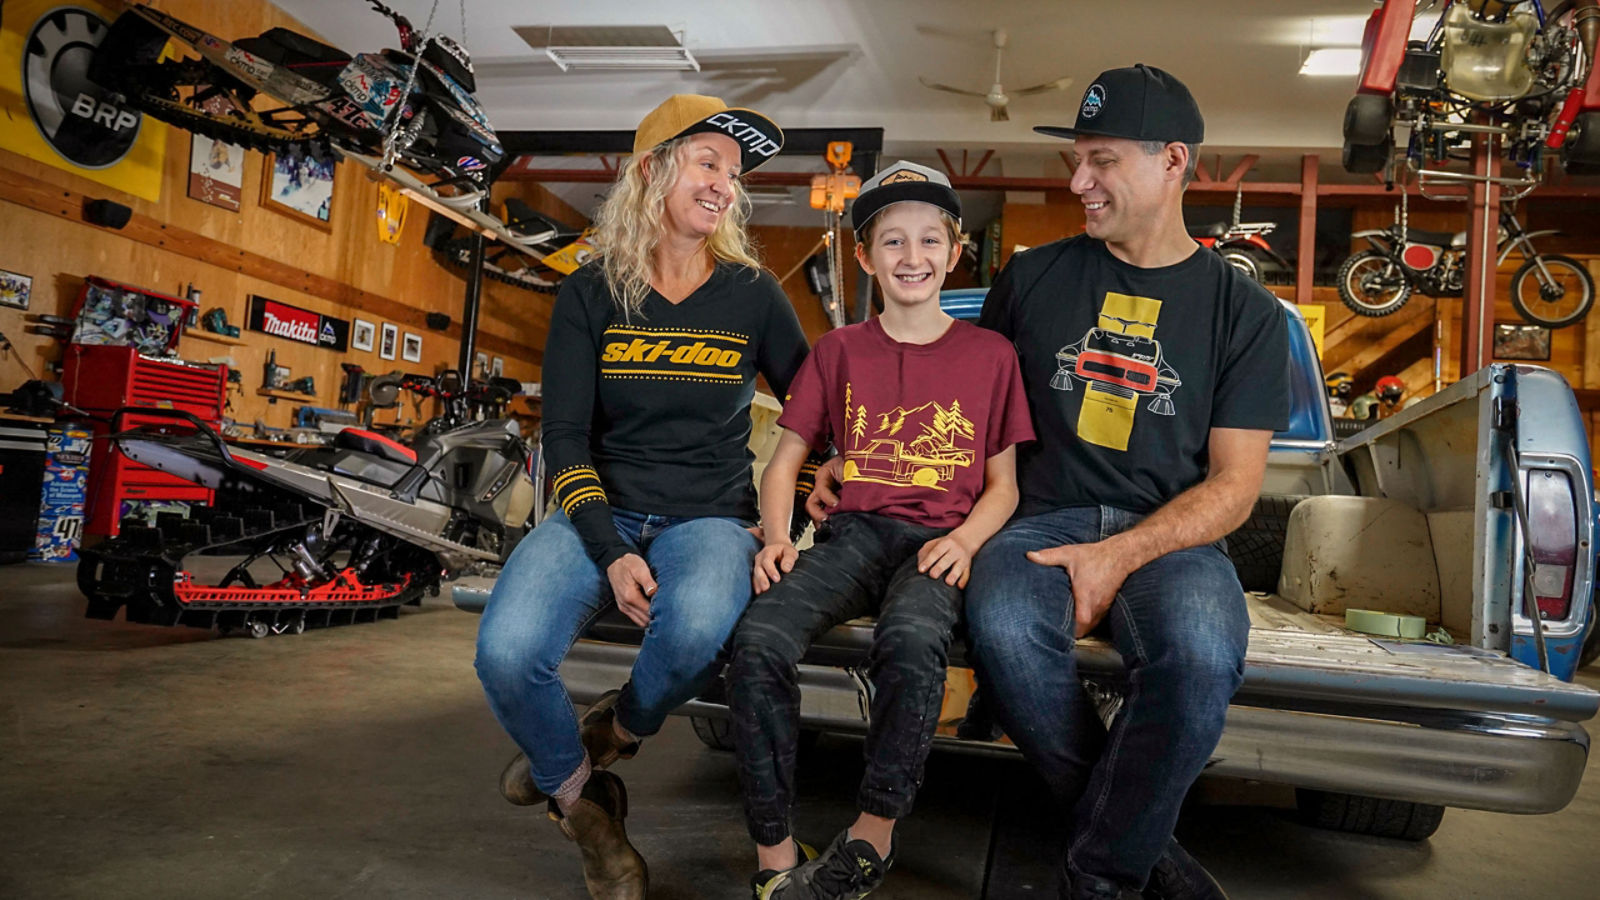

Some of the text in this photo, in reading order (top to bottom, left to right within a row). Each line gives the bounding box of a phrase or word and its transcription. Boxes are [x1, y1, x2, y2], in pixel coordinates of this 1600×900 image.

[344, 79, 368, 102] ckmp
[71, 93, 137, 132] BRP
[264, 312, 318, 344] Makita
